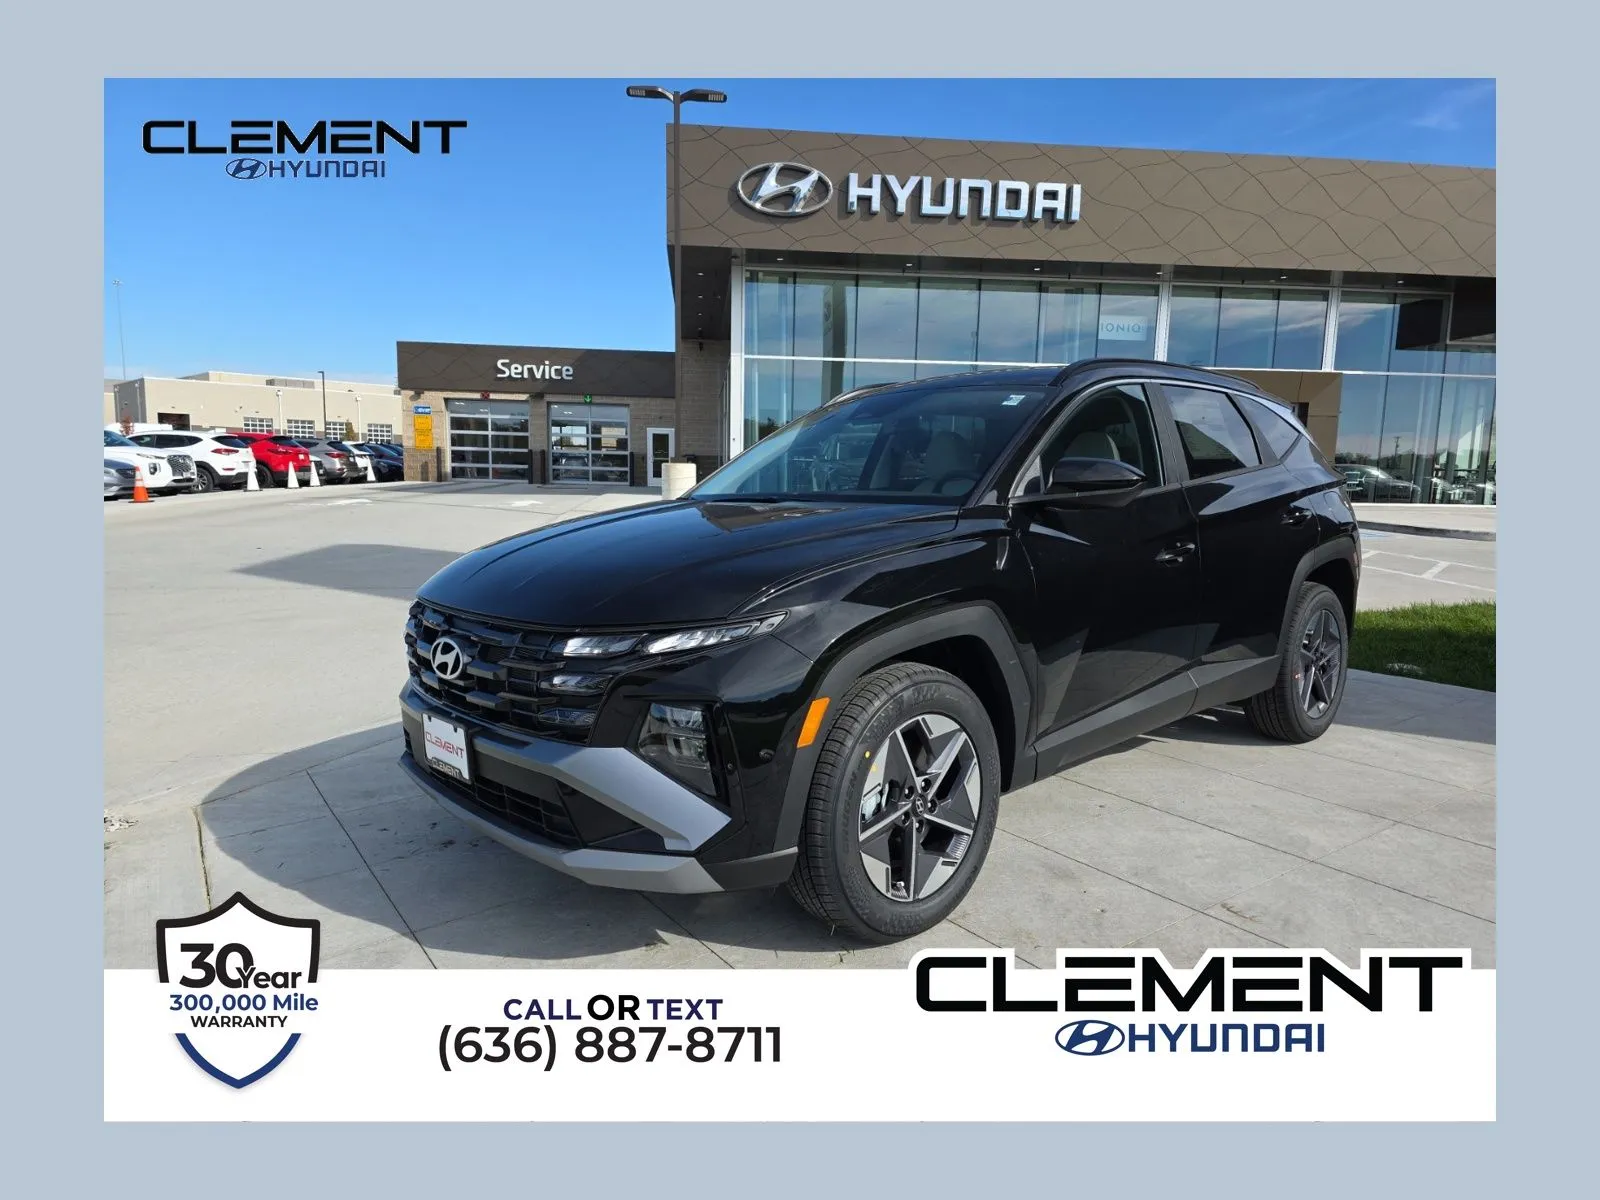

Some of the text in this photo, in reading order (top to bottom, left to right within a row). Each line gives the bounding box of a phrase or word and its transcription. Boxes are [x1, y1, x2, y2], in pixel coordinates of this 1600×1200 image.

[848, 172, 1082, 223] HYUNDAI
[1100, 322, 1141, 333] IONIQ
[496, 358, 574, 380] Service
[425, 731, 465, 759] CLEMENT
[431, 758, 461, 778] CLEMENT
